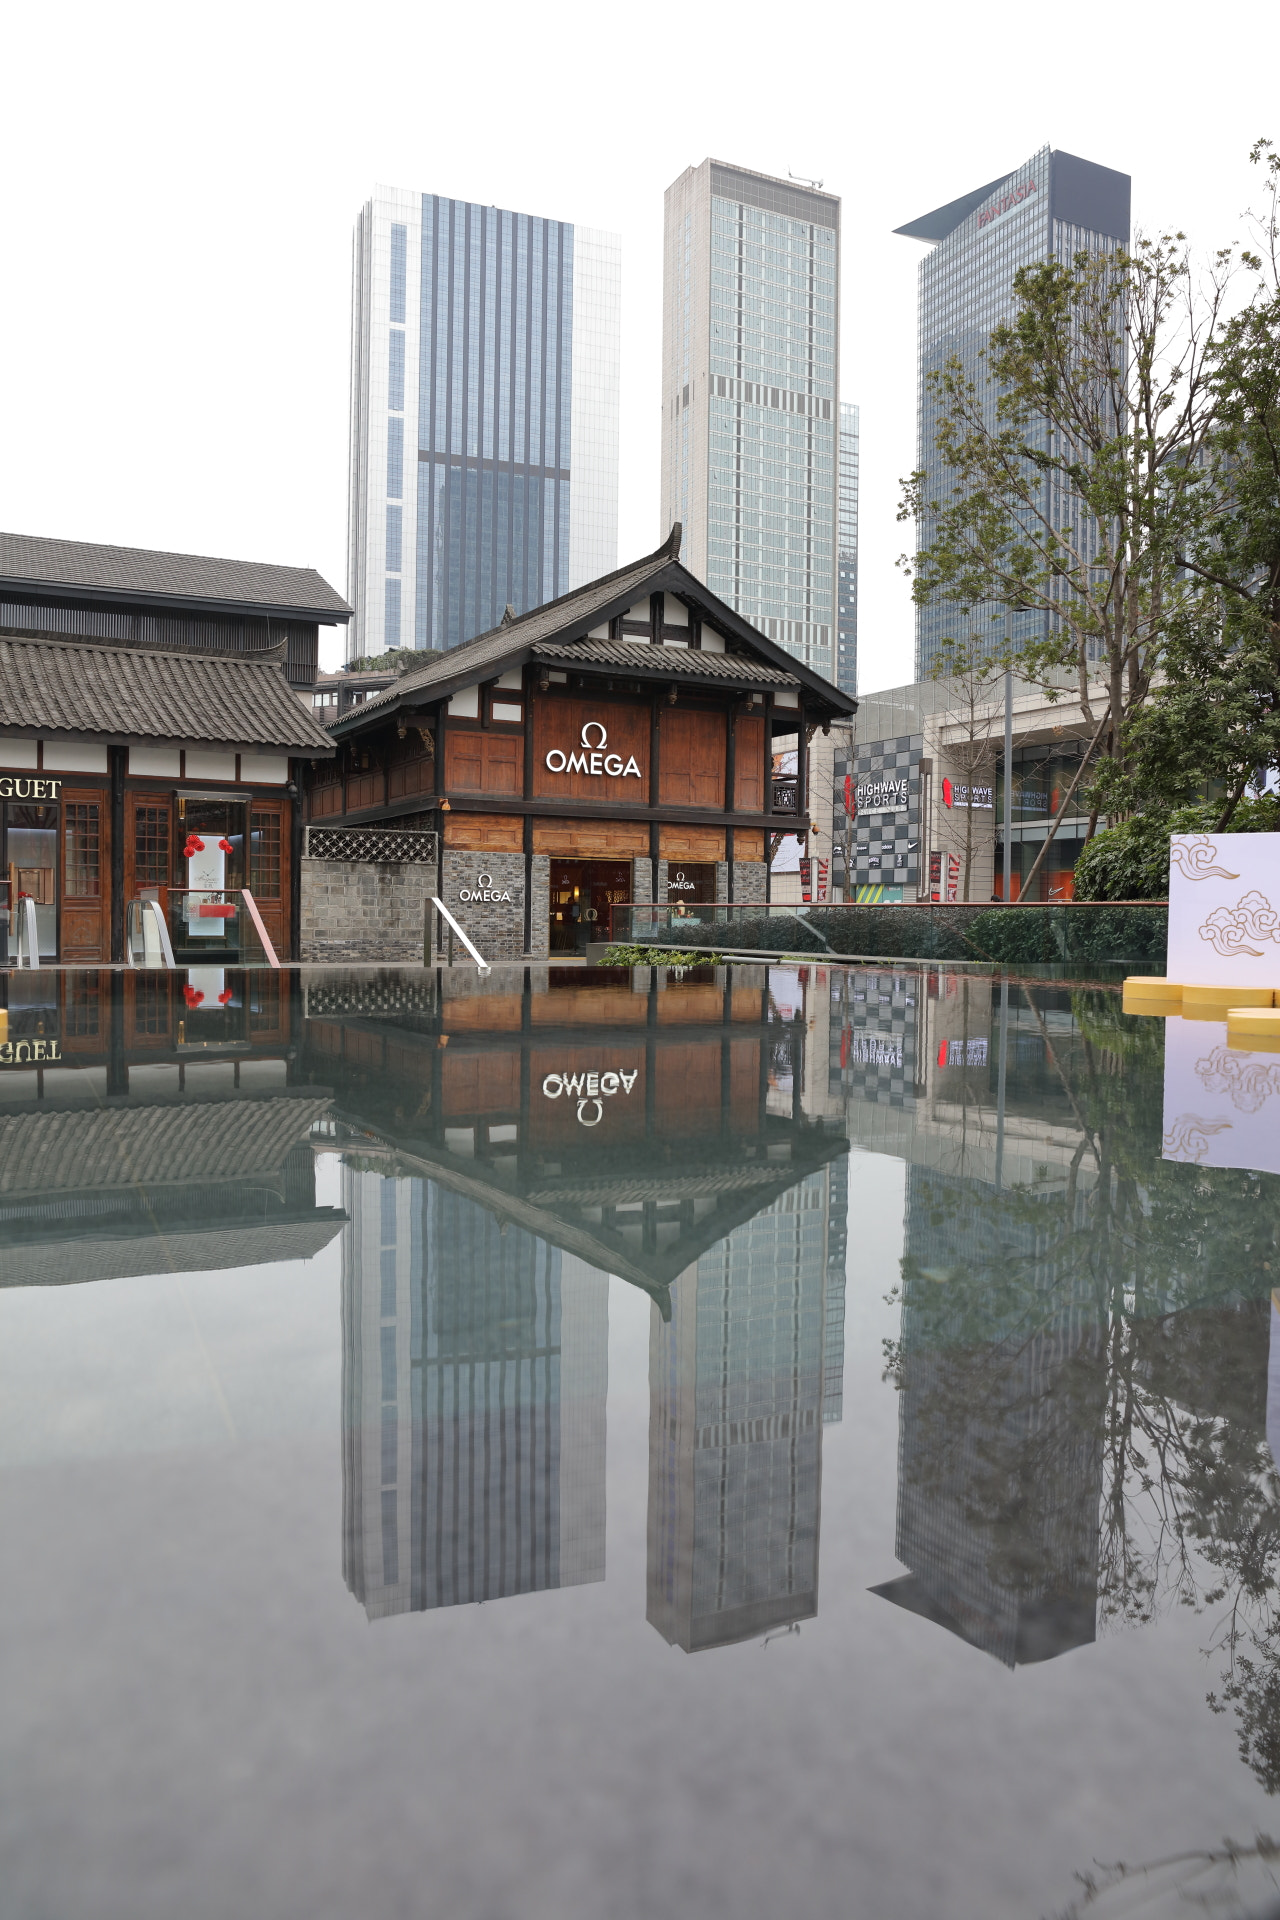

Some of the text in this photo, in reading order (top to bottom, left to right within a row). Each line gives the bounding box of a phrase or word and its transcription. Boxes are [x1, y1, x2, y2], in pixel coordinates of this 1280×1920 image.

[977, 179, 1037, 229] FANTASIA
[546, 749, 642, 778] OMEGA
[0, 777, 62, 799] GUET
[857, 779, 908, 797] HIGHWAVE
[857, 791, 908, 809] SPORTS
[954, 793, 993, 804] SPRTS
[668, 881, 696, 890] OMEGA
[460, 889, 511, 902] OMEGA
